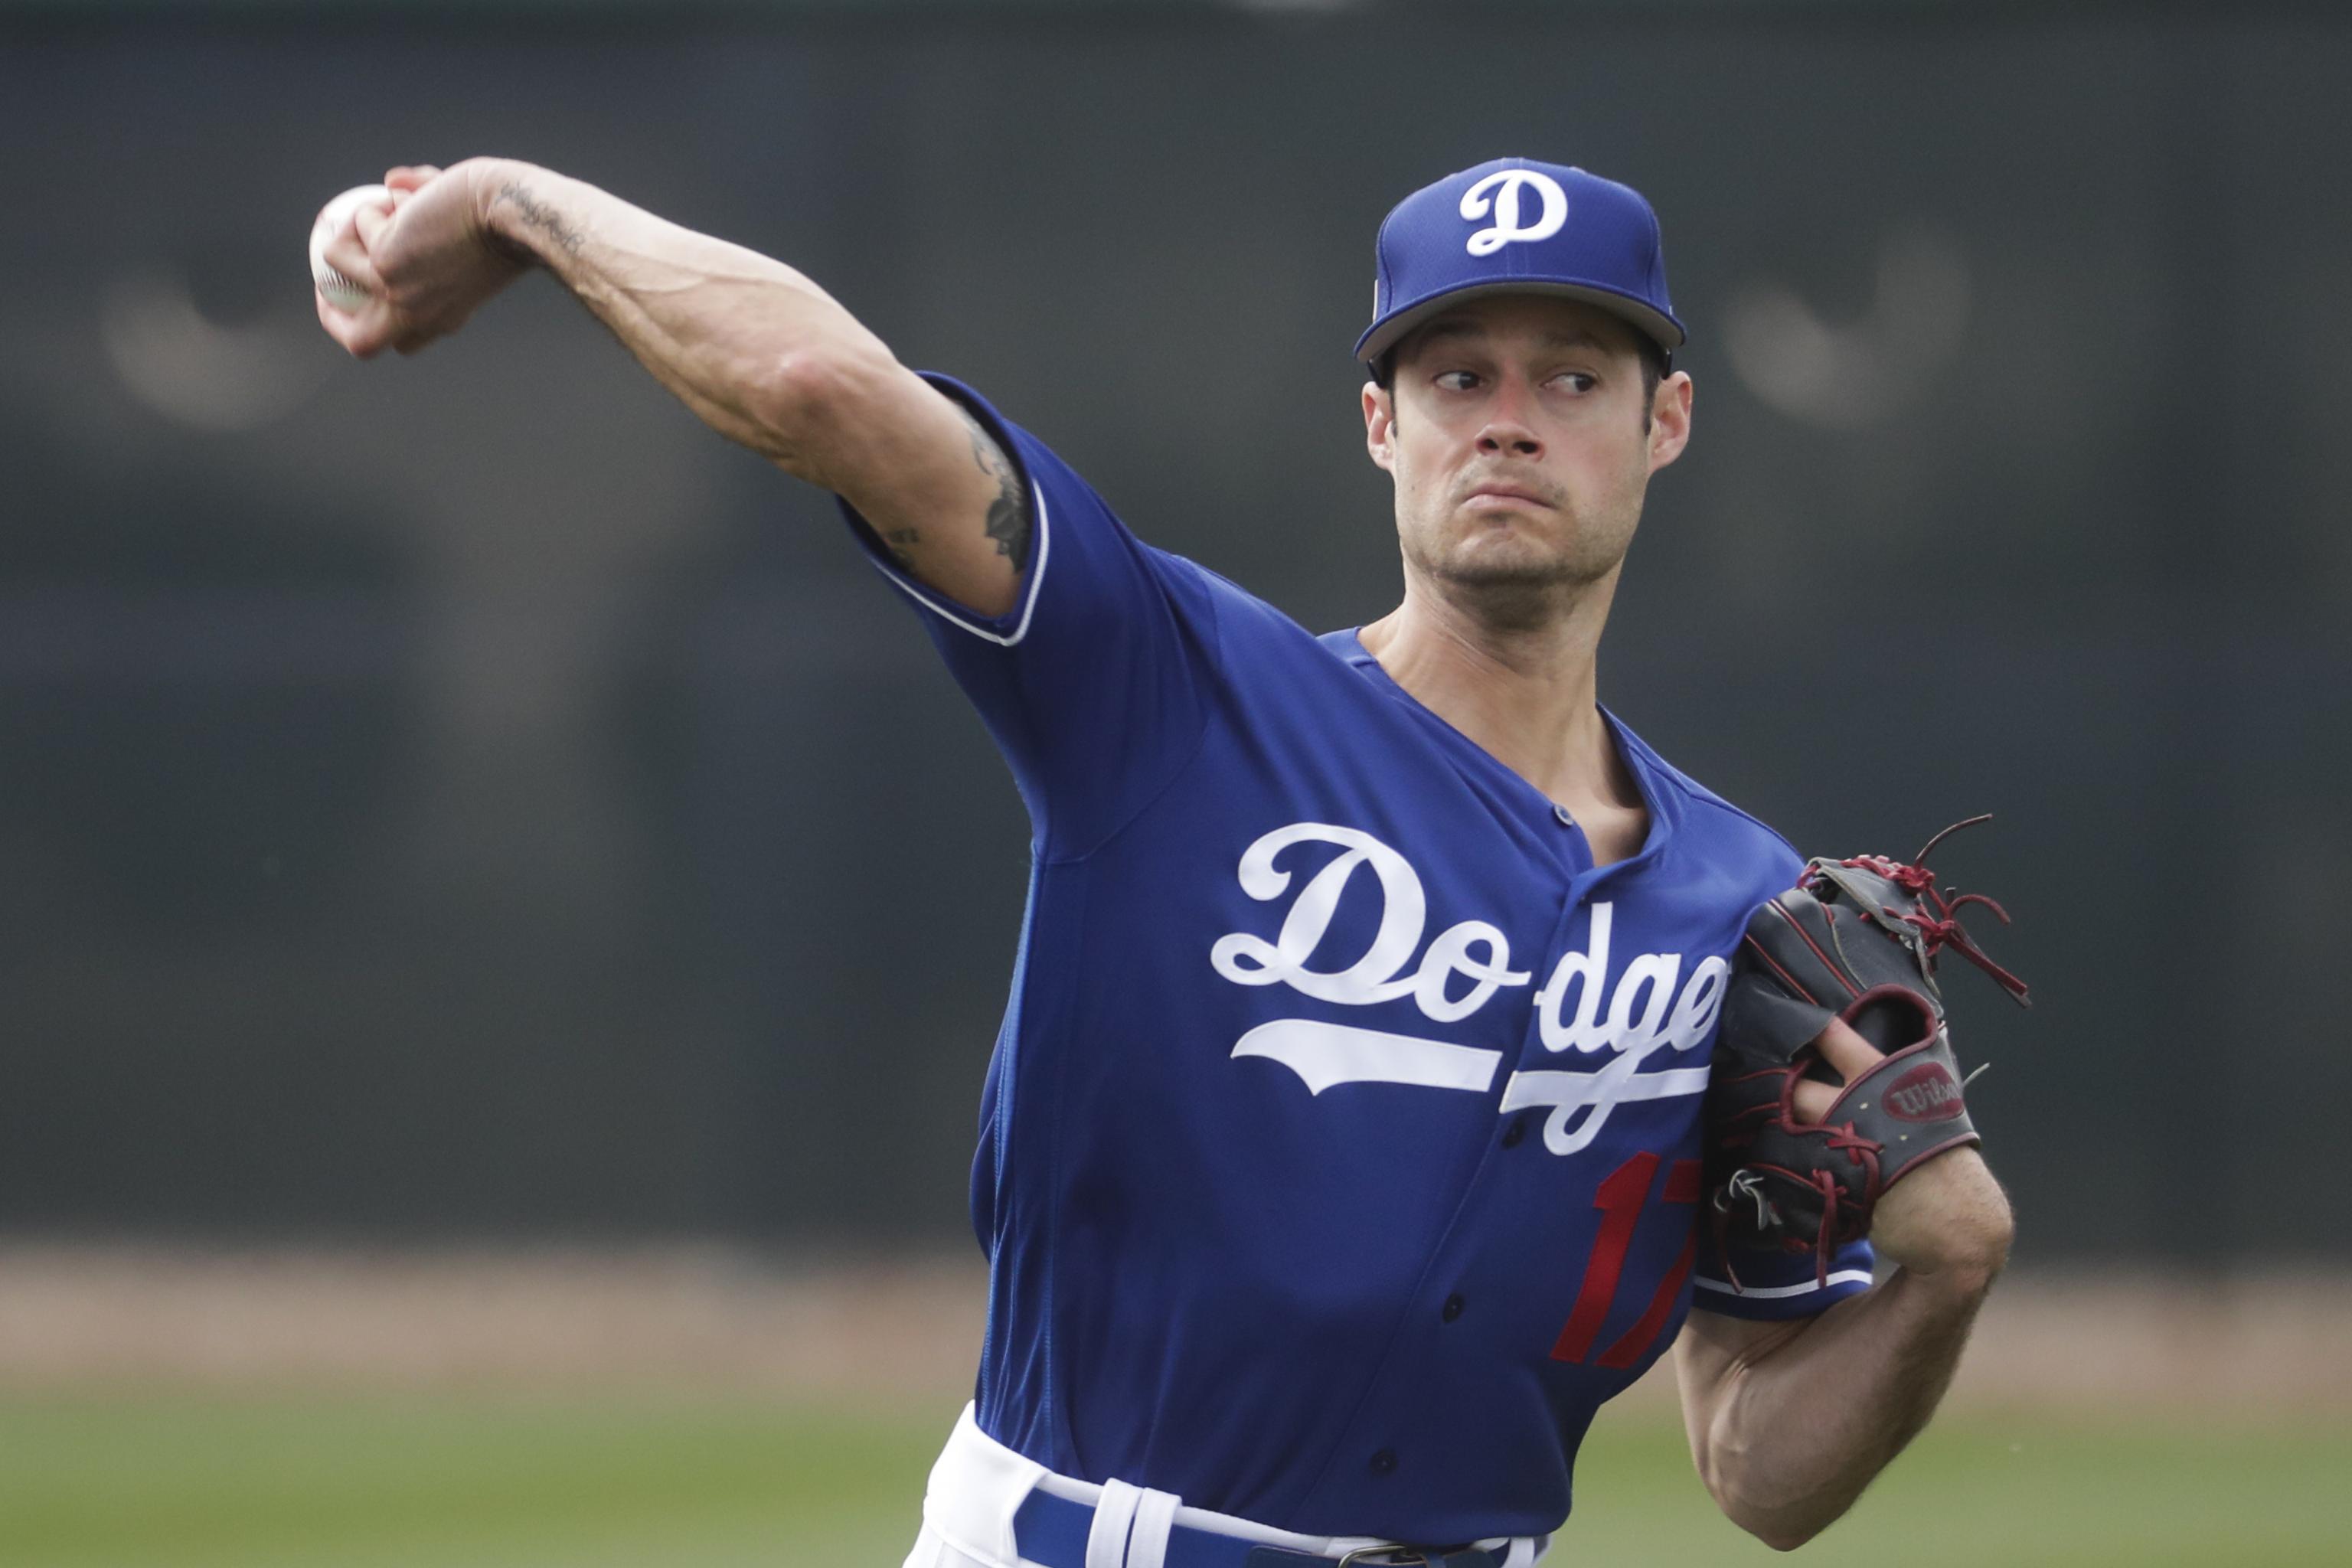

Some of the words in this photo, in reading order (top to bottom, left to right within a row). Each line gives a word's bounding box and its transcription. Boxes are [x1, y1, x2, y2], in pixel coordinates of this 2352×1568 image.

[1459, 169, 1569, 257] D
[1210, 822, 1732, 1156] Dodge
[1549, 1151, 1702, 1370] 17
